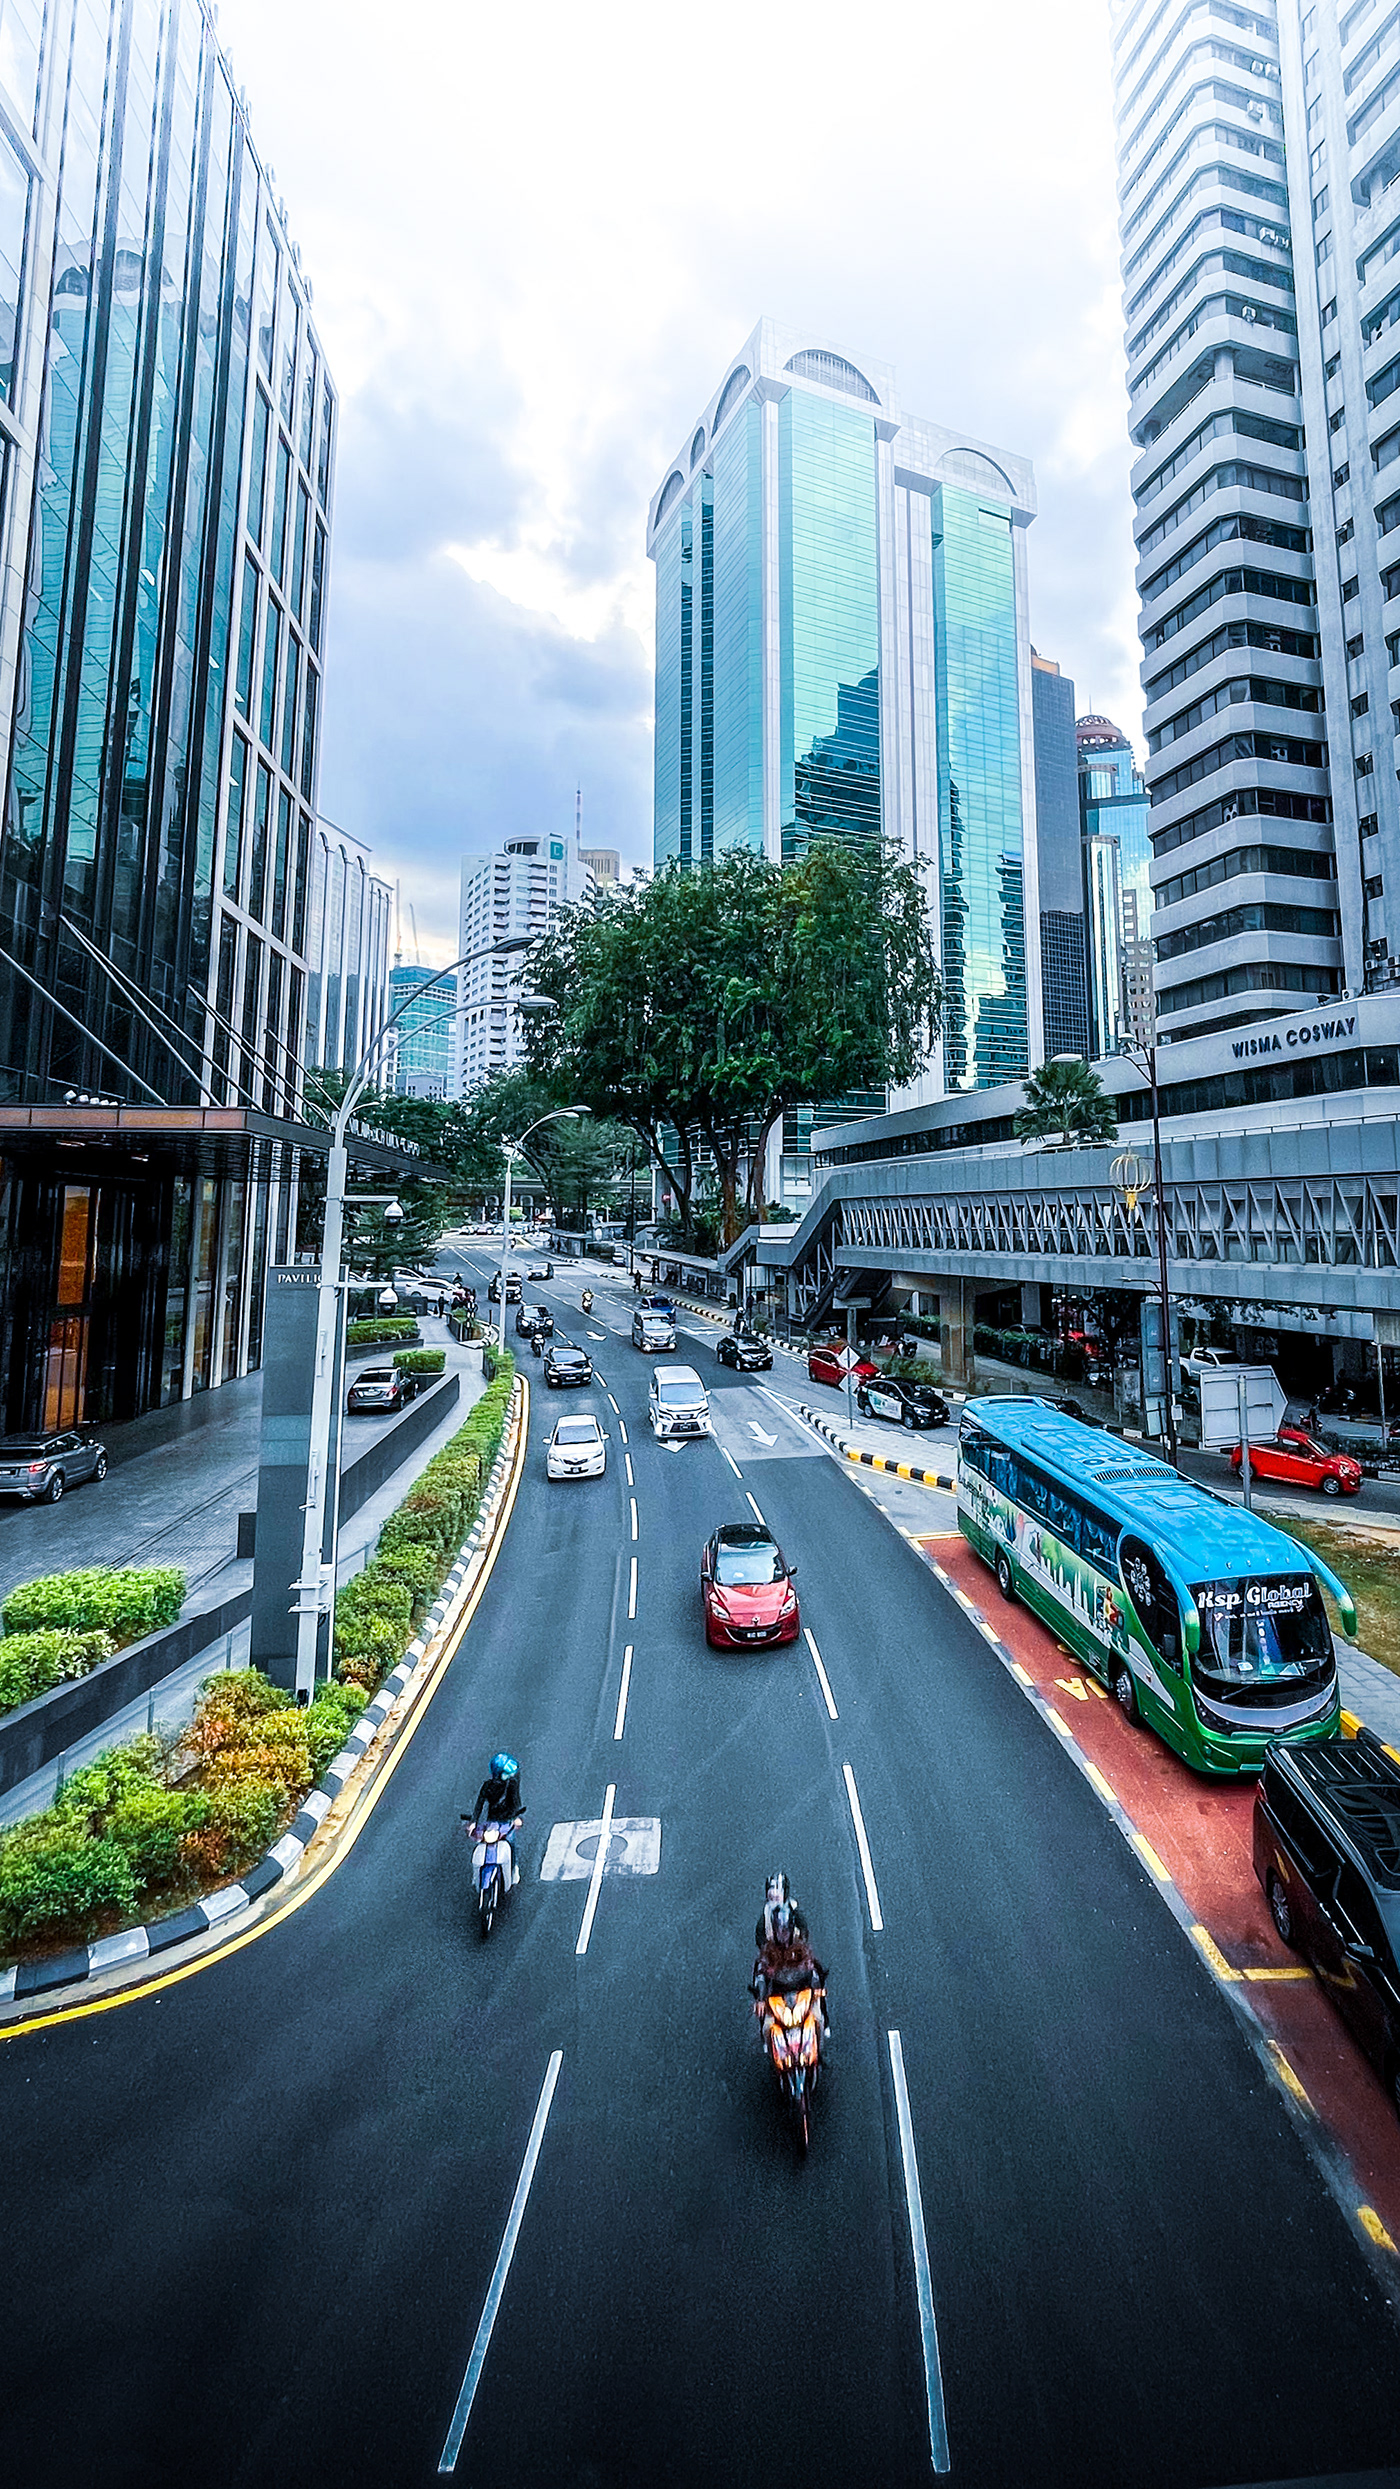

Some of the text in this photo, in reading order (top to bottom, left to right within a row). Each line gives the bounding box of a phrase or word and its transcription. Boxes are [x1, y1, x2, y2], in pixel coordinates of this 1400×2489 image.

[1231, 1017, 1356, 1058] WISMA COSWAY
[1197, 1582, 1313, 1610] Ksp Global
